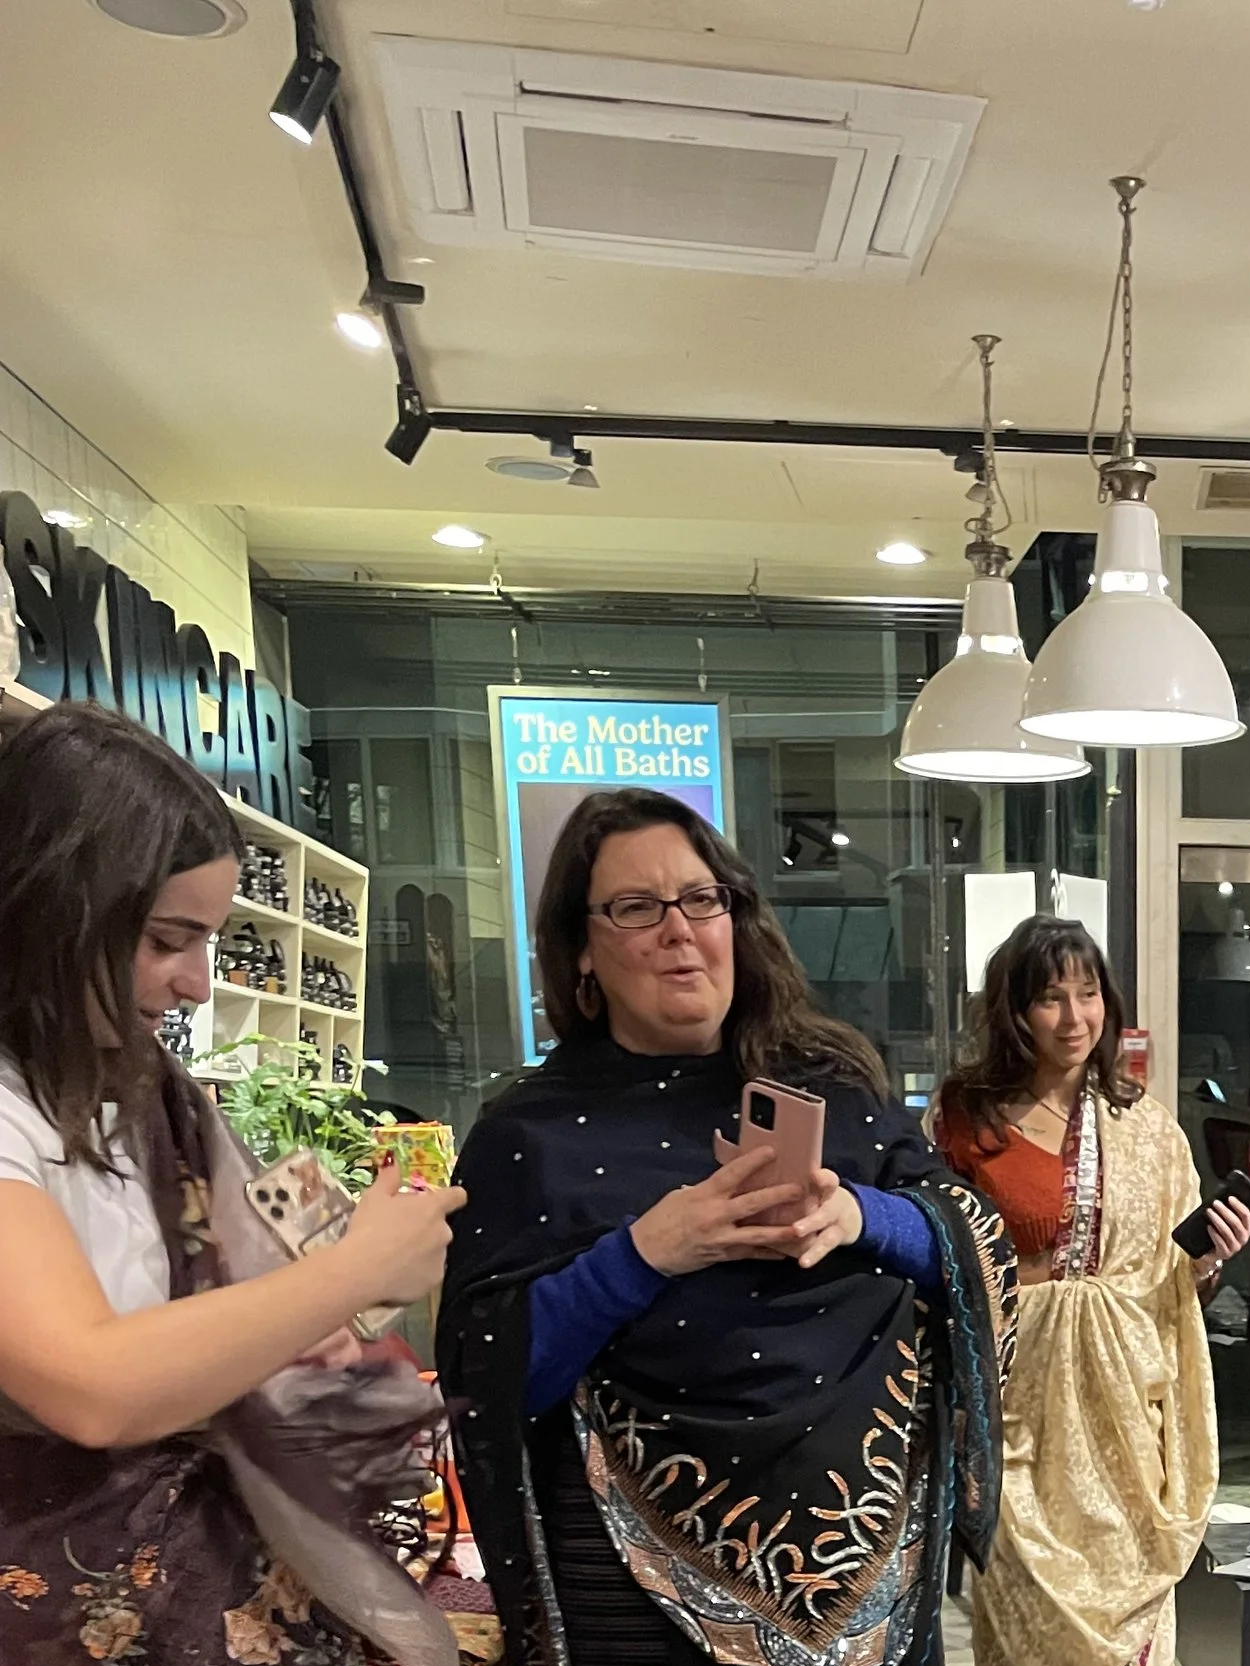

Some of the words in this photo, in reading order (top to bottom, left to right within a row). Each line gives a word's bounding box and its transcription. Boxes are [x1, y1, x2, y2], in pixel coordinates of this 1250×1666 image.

[513, 712, 578, 743] The
[587, 715, 709, 746] Mother
[517, 744, 552, 774] of
[560, 745, 605, 776] All
[614, 747, 710, 778] Baths
